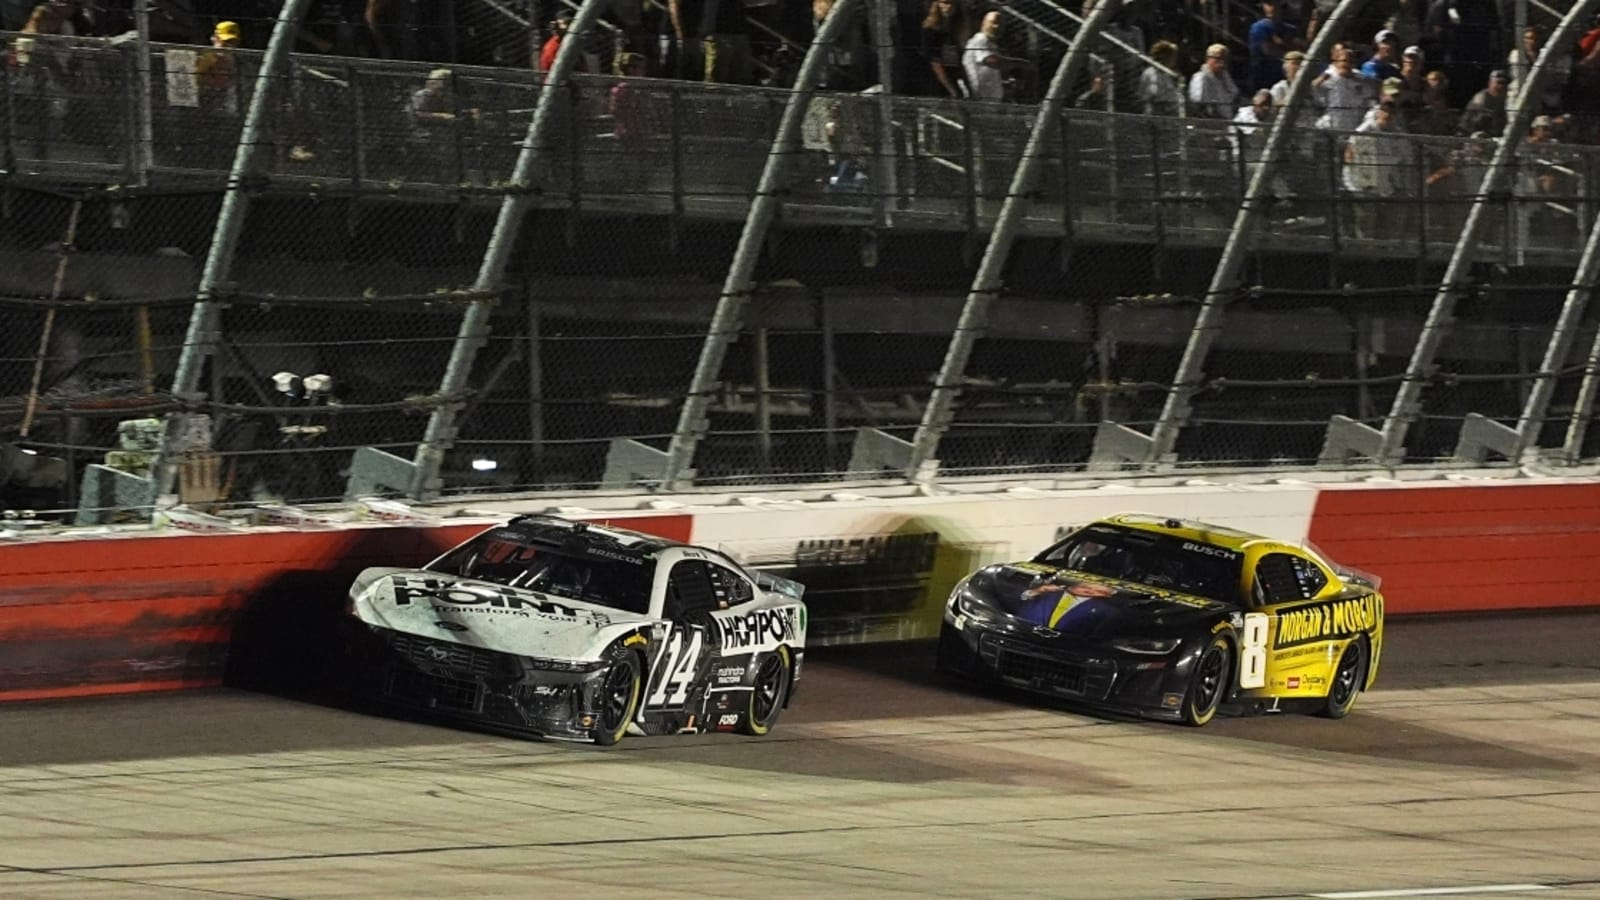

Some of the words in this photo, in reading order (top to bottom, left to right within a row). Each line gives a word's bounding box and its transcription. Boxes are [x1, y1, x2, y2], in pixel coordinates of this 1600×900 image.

[586, 548, 644, 566] BRISCOE
[1182, 542, 1236, 561] BUSCH
[1278, 606, 1322, 645] MORGAN
[1322, 604, 1331, 636] &
[647, 630, 703, 706] 14
[1240, 612, 1270, 690] 8
